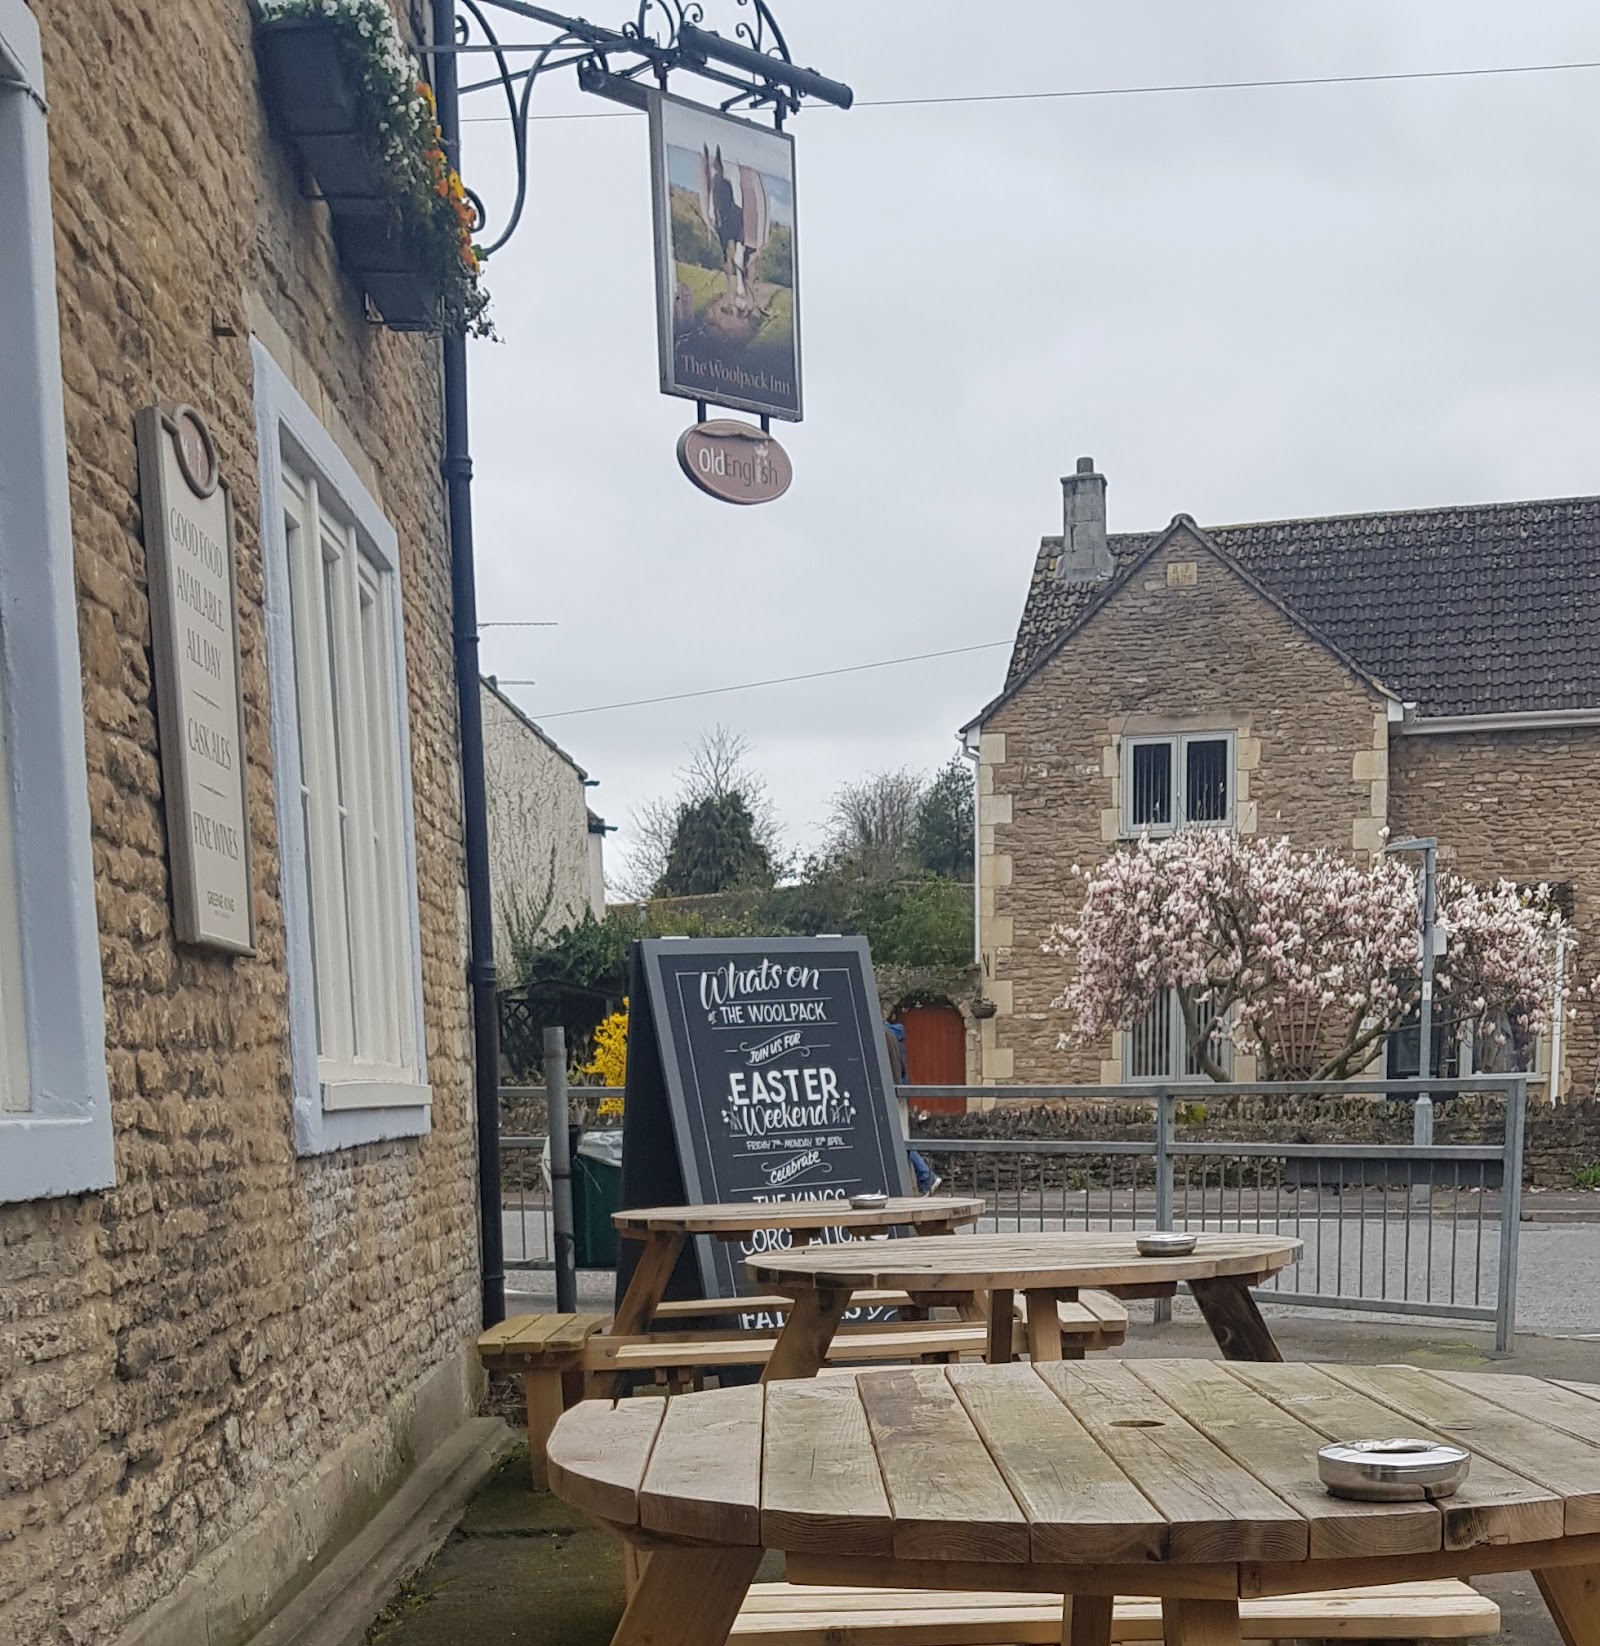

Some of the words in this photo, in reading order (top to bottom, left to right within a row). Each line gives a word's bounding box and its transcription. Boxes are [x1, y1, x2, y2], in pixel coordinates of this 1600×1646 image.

[682, 354, 707, 376] The
[708, 360, 769, 389] Woolpack
[770, 374, 791, 395] Inn
[170, 507, 198, 557] GOOD
[199, 530, 223, 579] FOOD
[176, 566, 225, 632] AVAILABLE
[186, 627, 204, 668] ALL
[203, 638, 222, 680] DAY
[188, 717, 212, 761] CASK
[210, 730, 232, 770] ALES
[193, 811, 213, 850] FINE
[212, 818, 239, 861] WINES
[700, 957, 783, 1011] Whats
[786, 965, 820, 991] on
[720, 1006, 746, 1024] THE
[748, 1002, 827, 1023] WOOLPACK
[749, 1046, 769, 1064] JOIN
[770, 1038, 783, 1056] US
[784, 1032, 802, 1050] FOR
[729, 1067, 841, 1106] EASTER
[743, 1097, 829, 1136] Weekend
[746, 1140, 770, 1150] FRIDAY
[784, 1137, 812, 1148] MONDAY
[827, 1135, 846, 1147] APRIL
